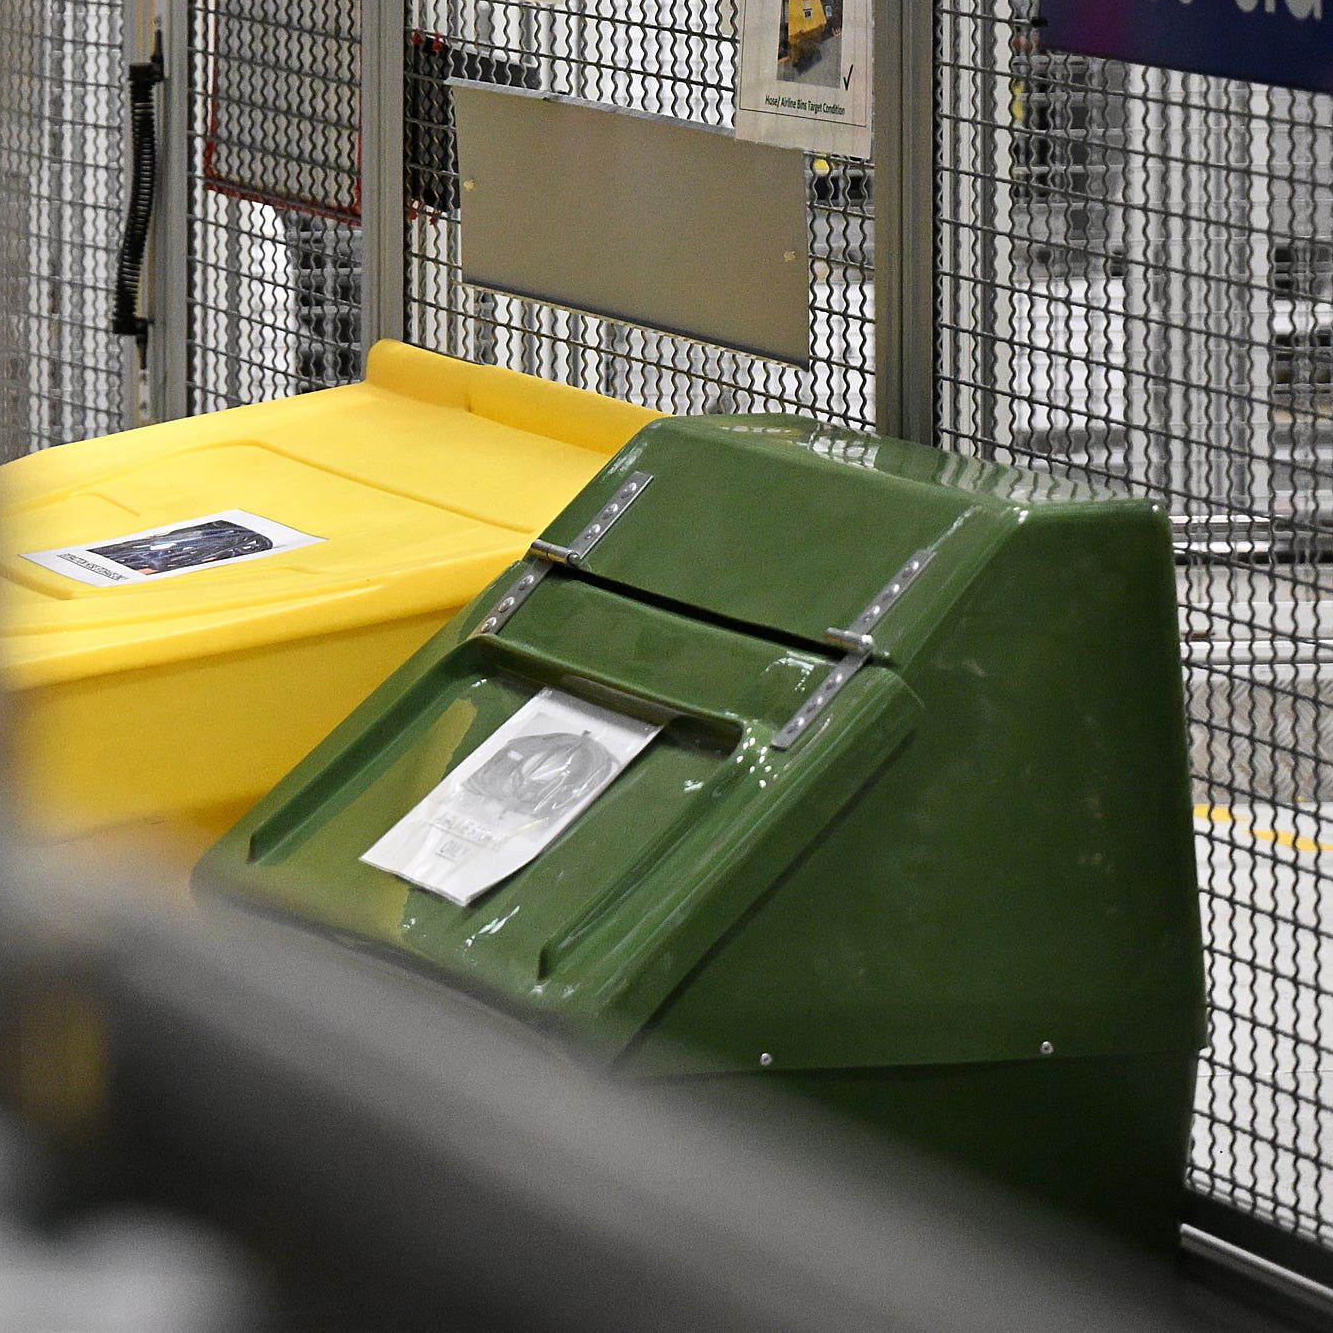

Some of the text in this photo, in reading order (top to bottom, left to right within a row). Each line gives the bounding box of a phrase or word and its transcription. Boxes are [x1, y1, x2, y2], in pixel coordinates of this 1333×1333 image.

[765, 95, 846, 115] Hose/ Airline Bins Target Condition
